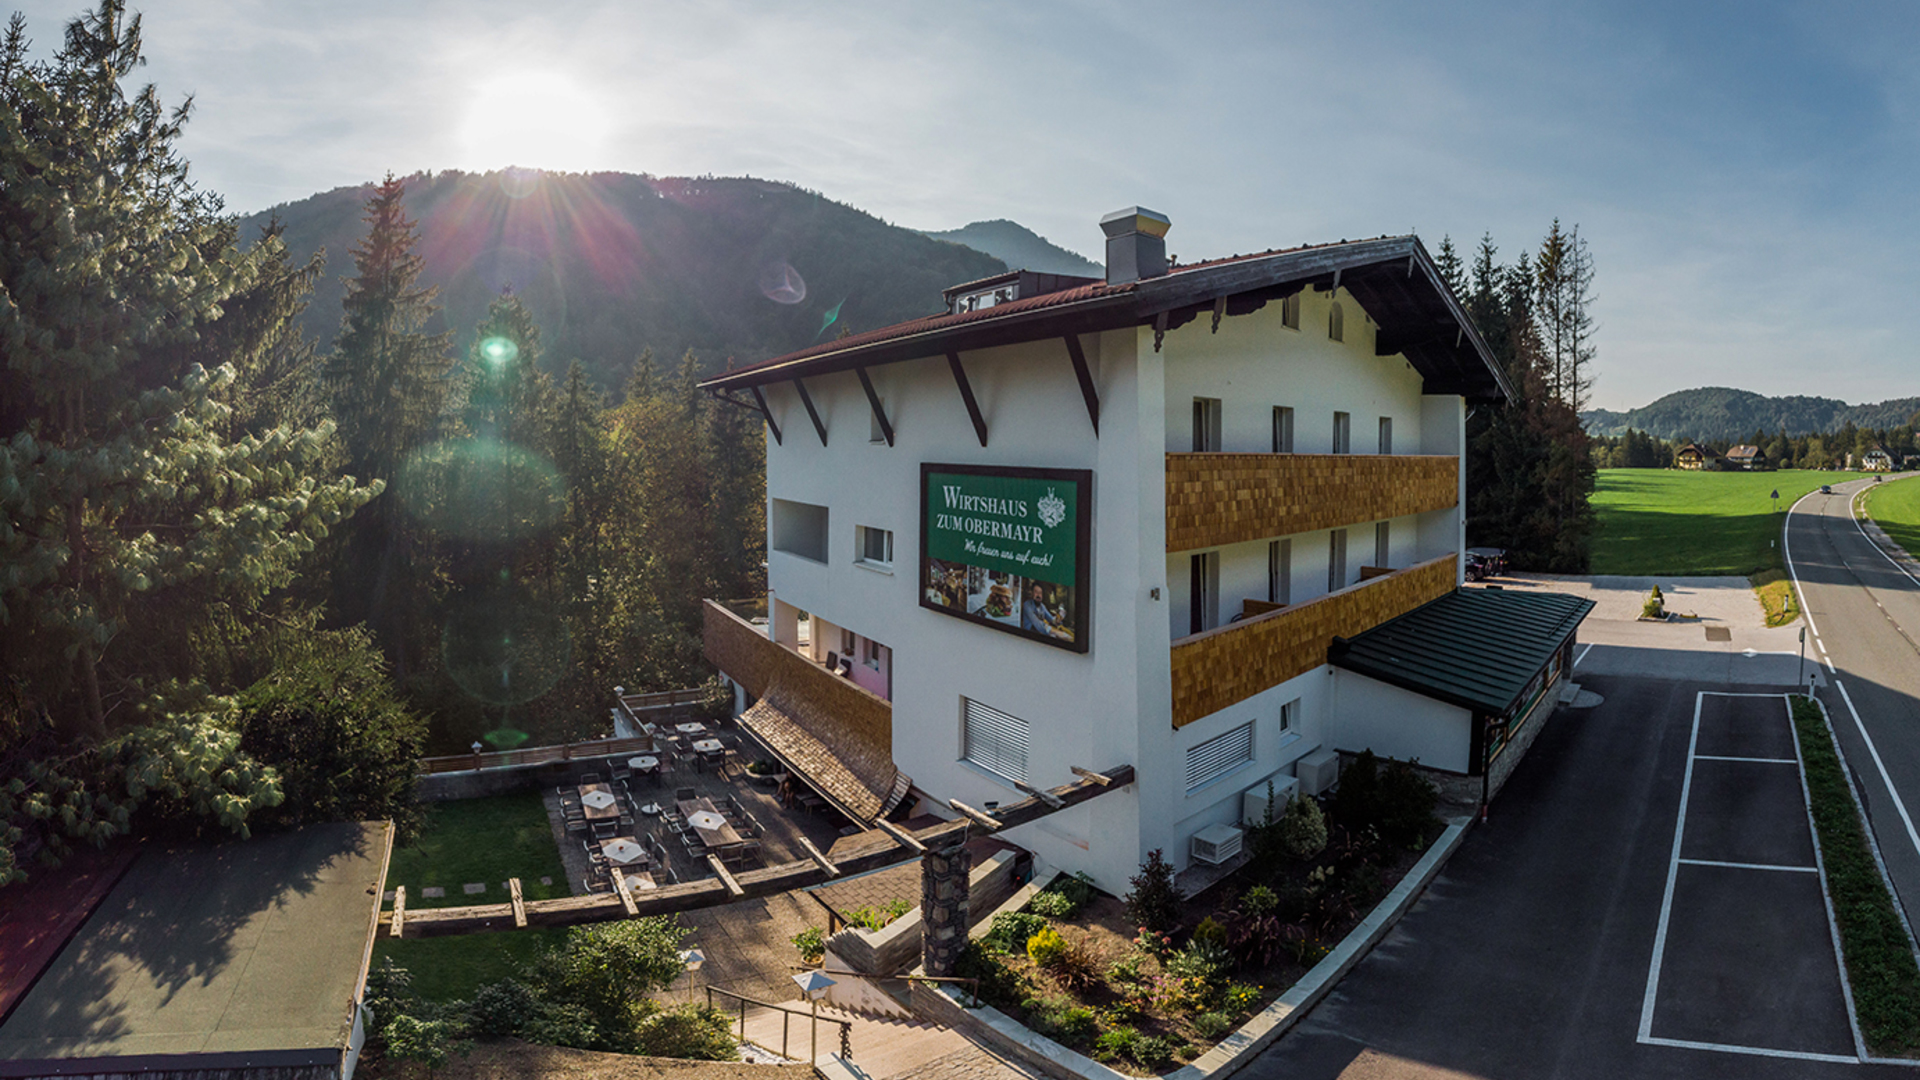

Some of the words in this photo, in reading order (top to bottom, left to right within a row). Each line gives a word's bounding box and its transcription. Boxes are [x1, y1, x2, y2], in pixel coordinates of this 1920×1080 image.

[943, 485, 1028, 518] WIRTSHAUS
[936, 513, 963, 532] ZUM
[964, 517, 1043, 544] OBERMAYR
